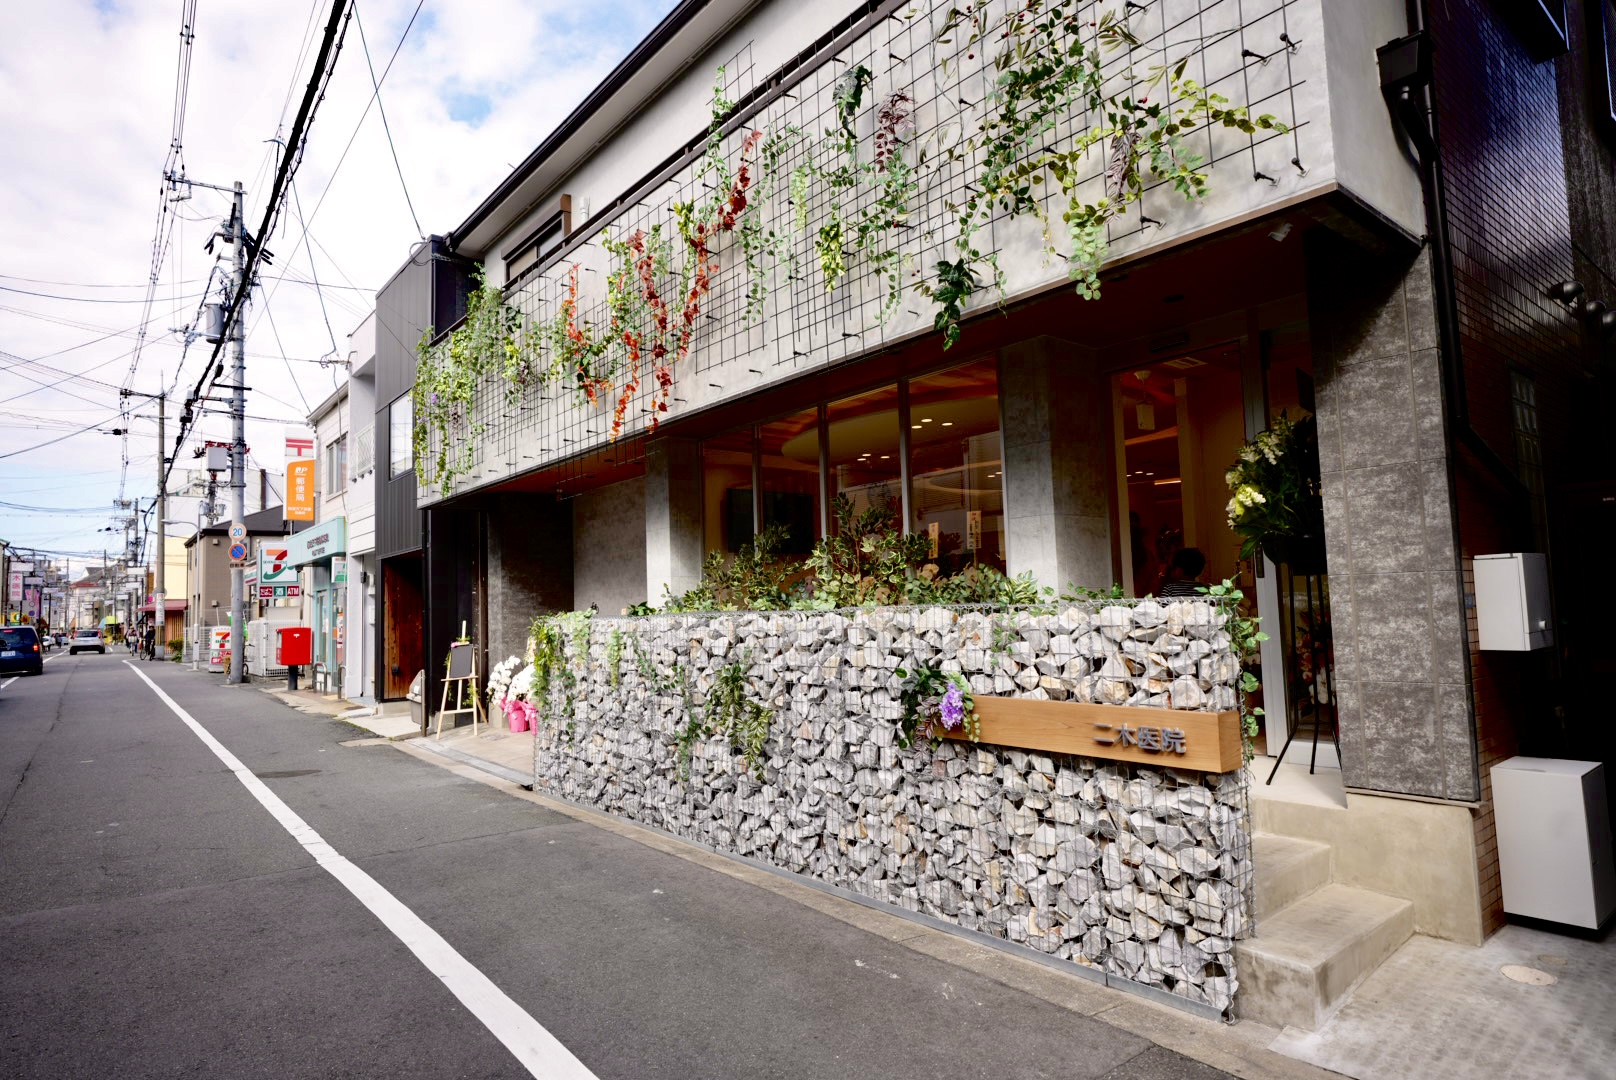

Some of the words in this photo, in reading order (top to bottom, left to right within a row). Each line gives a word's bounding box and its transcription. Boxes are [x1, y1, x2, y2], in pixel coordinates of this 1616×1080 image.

[295, 477, 305, 502] 郵便局
[232, 528, 242, 536] 20
[287, 587, 299, 596] ATM
[1093, 723, 1187, 754] 二木医院
